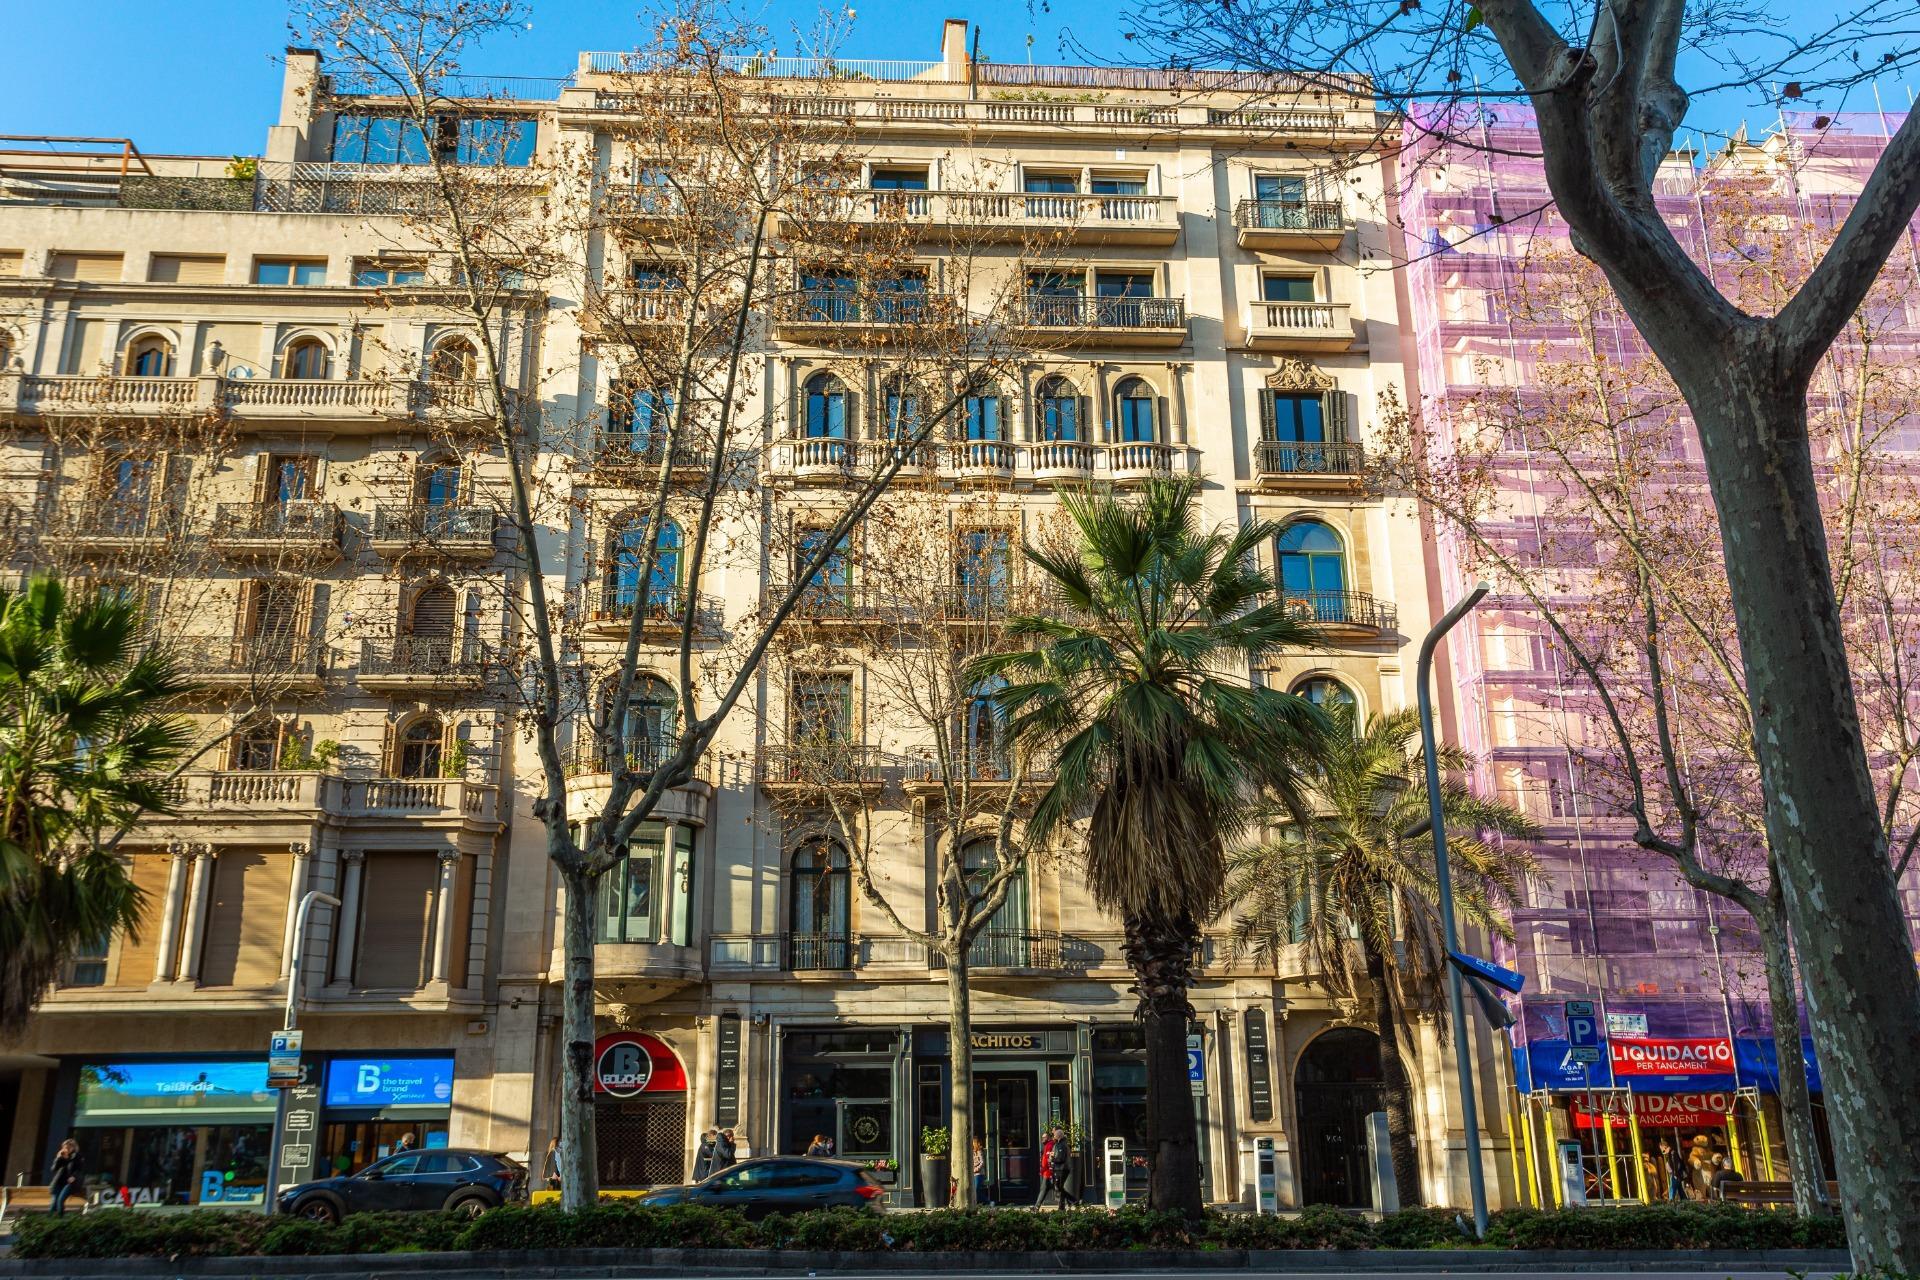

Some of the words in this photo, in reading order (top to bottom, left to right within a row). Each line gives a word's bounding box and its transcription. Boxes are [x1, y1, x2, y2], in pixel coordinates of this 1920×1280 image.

[970, 1035, 1032, 1047] ACHITOS
[1573, 1019, 1591, 1043] P
[275, 1039, 284, 1050] P
[1611, 1041, 1730, 1061] LIQUIDACIÓ
[614, 1047, 640, 1074] B
[1637, 1061, 1654, 1070] PER
[1656, 1061, 1708, 1070] TANCAMENT
[357, 1064, 381, 1093] B
[1640, 1114, 1700, 1124] ANCAMENT
[201, 1170, 225, 1203] B
